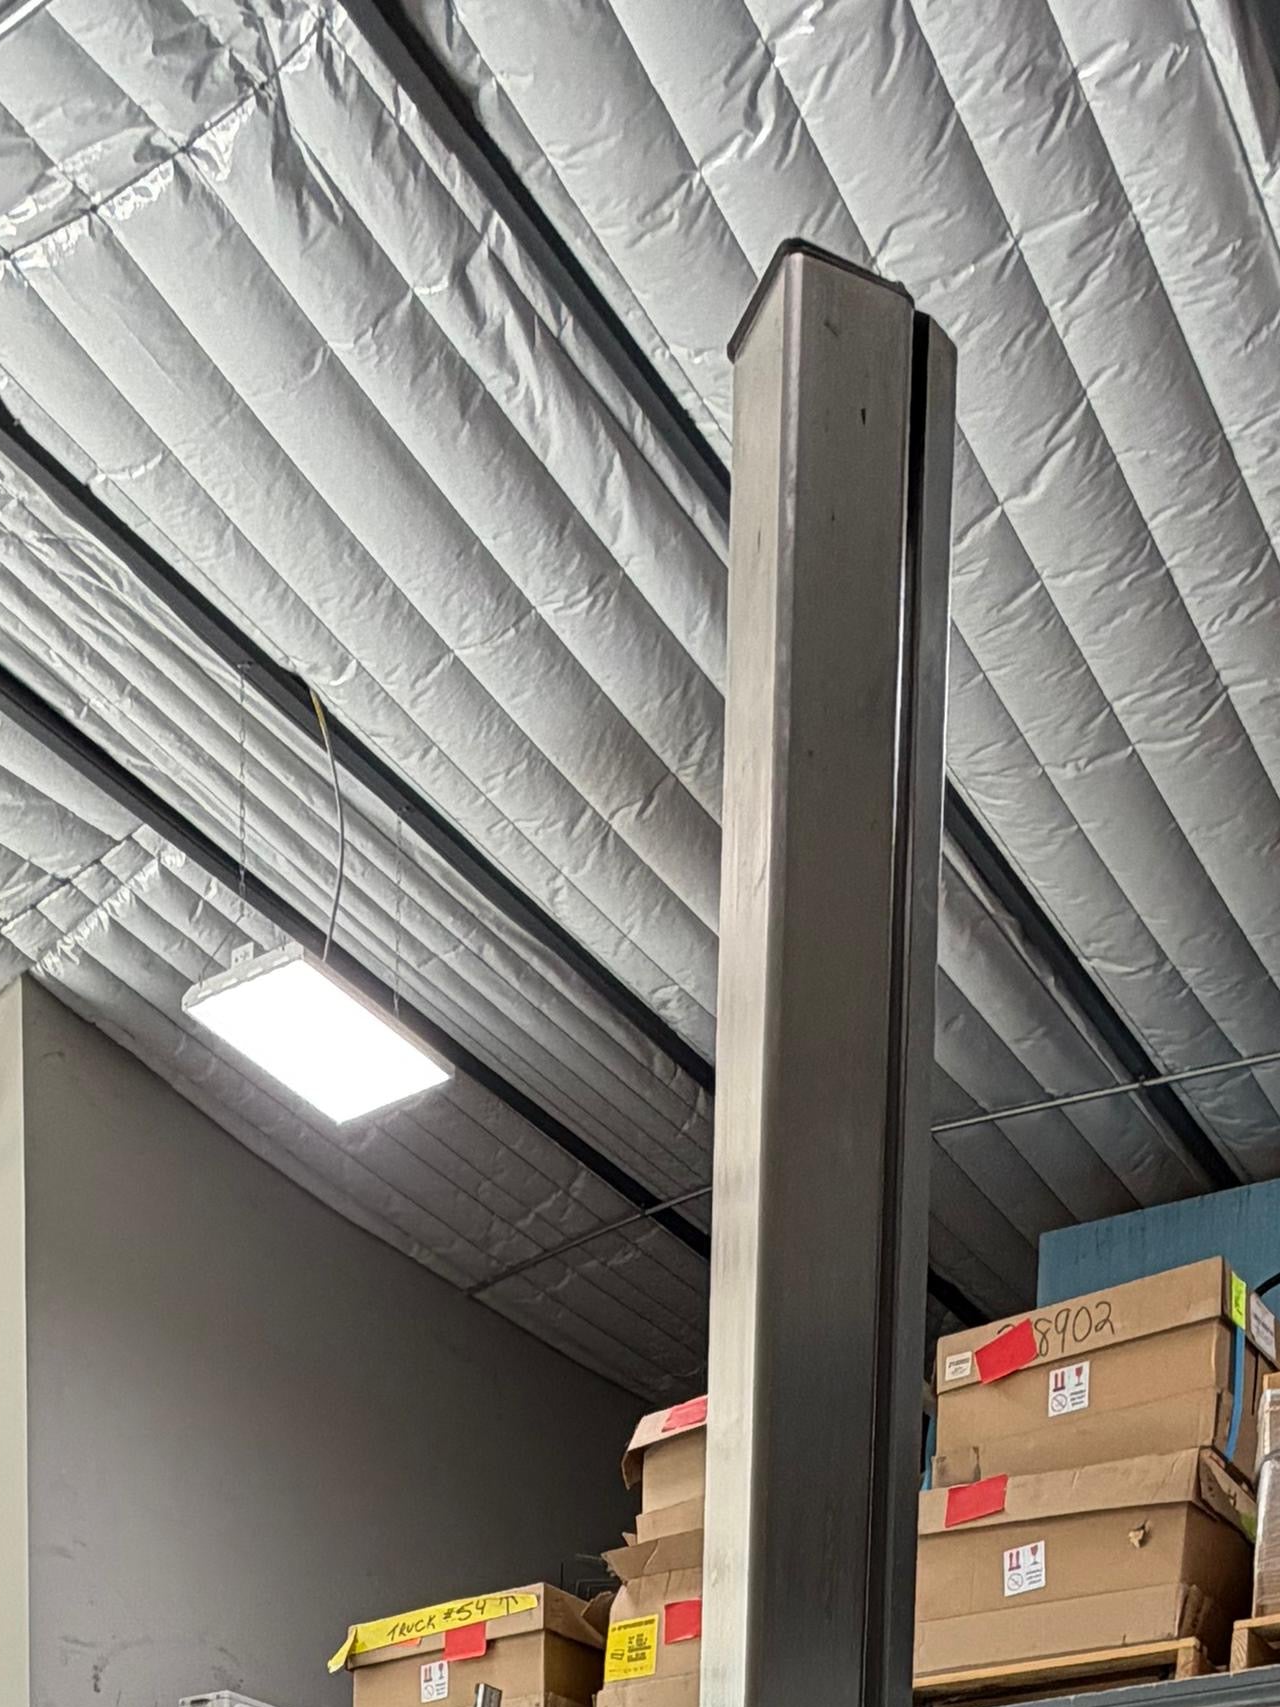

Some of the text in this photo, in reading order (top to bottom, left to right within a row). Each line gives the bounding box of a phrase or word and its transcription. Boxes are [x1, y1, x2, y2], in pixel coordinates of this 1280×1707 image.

[996, 1301, 1116, 1357] 8902
[386, 1601, 487, 1641] TRUCK #54
